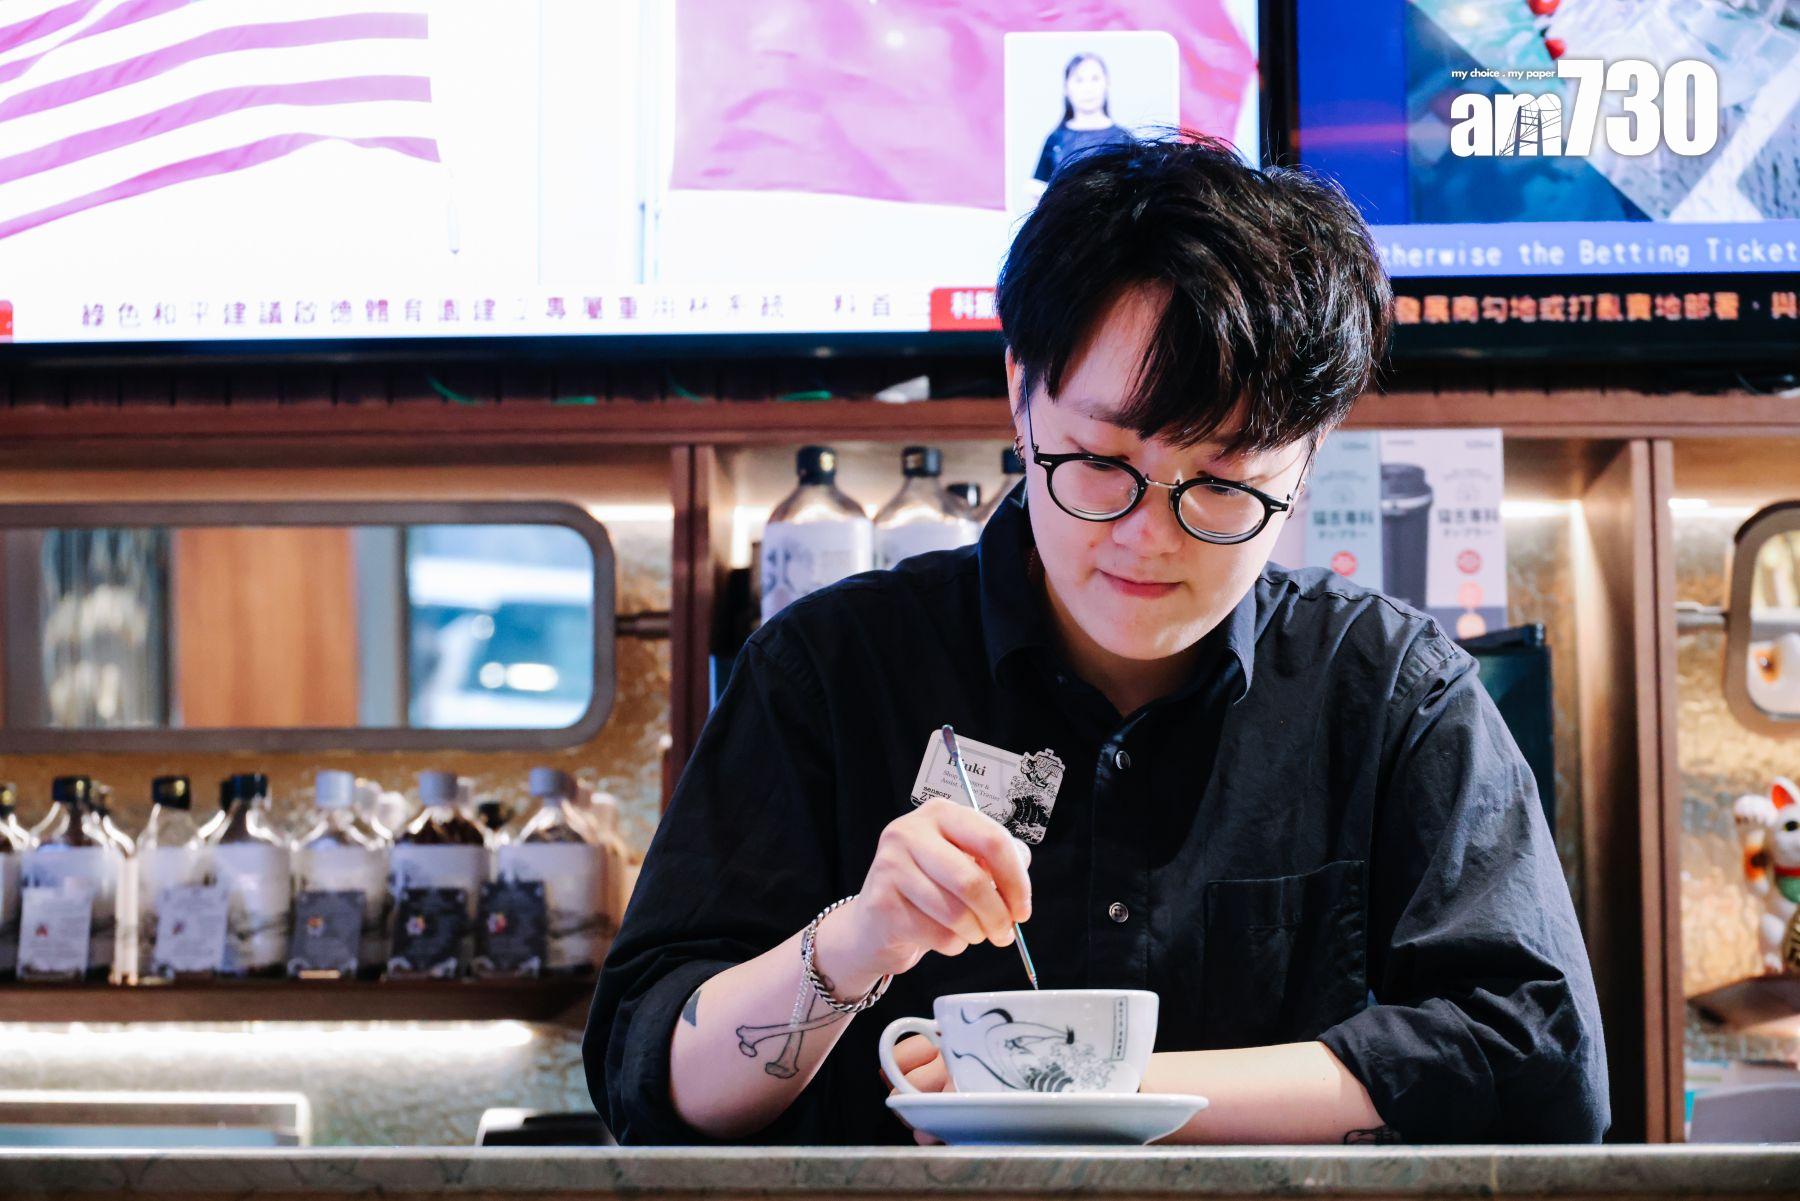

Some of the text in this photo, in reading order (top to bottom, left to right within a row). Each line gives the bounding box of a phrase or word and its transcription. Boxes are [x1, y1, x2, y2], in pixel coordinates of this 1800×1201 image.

[1518, 240, 1565, 266] the
[1578, 239, 1690, 268] Betting
[1706, 238, 1798, 264] Ticket
